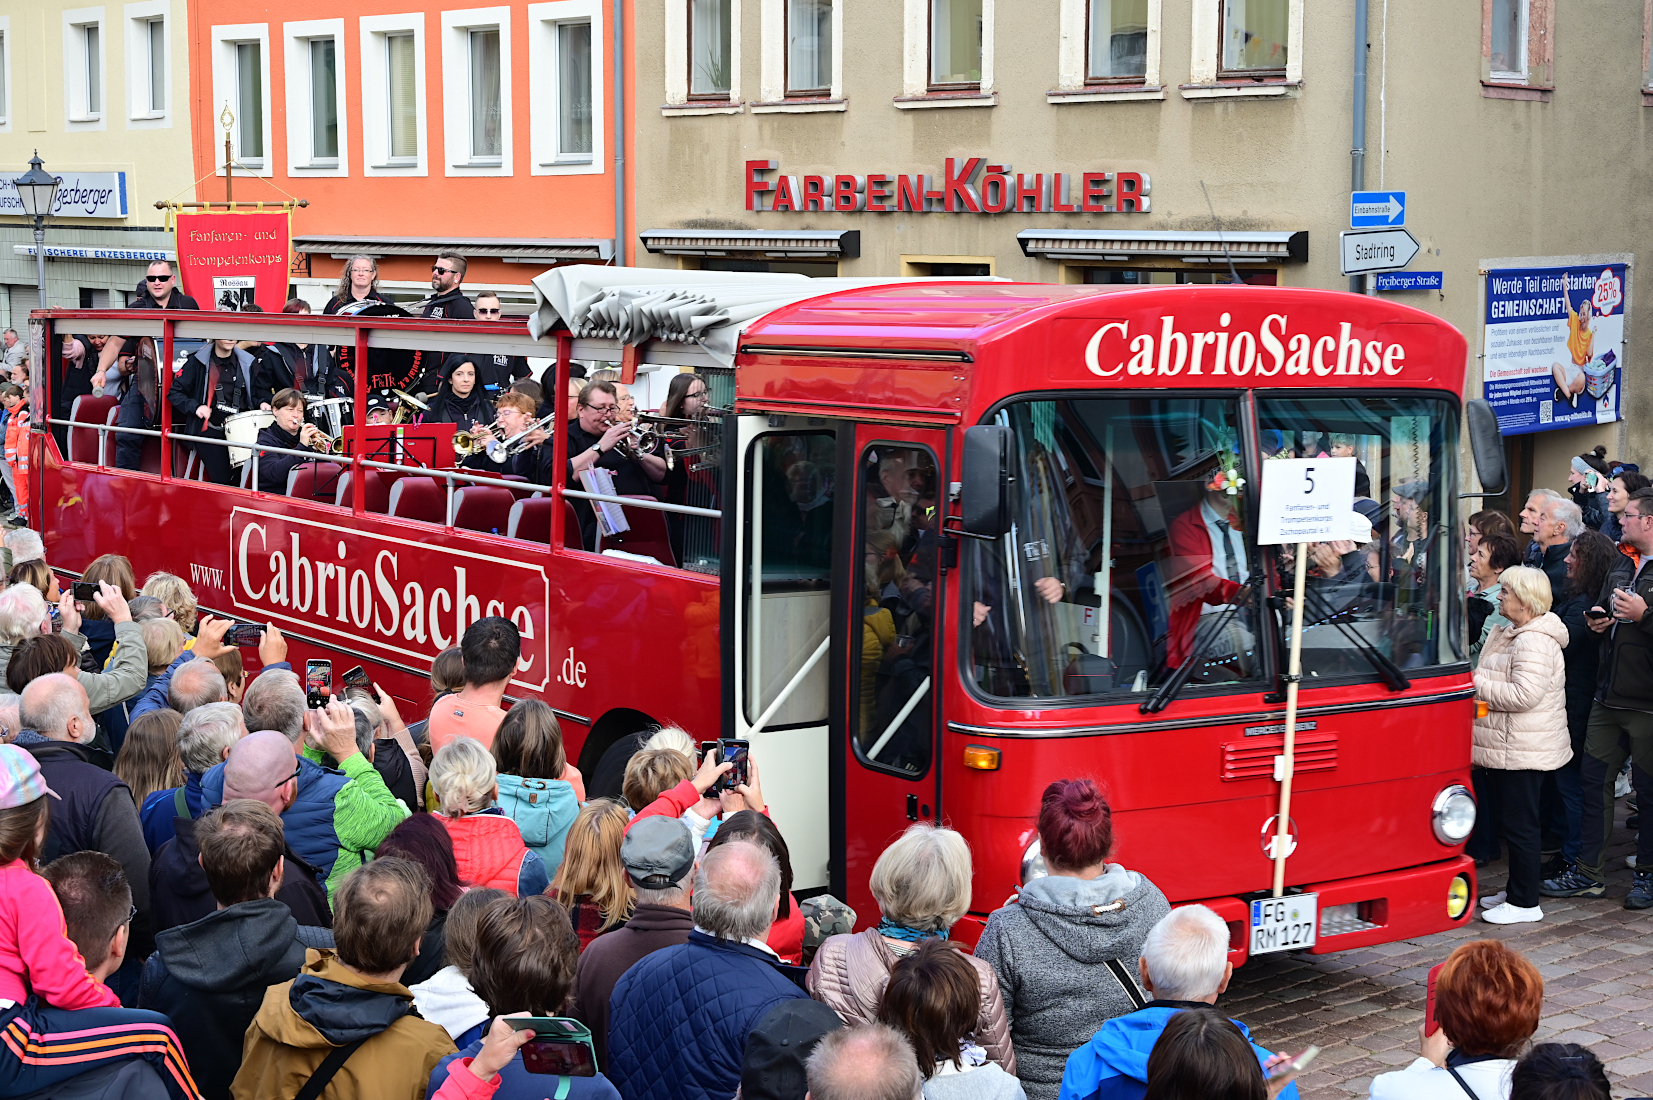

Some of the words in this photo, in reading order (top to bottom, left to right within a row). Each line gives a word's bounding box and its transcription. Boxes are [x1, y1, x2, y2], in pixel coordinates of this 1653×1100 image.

[745, 157, 1151, 214] FARBEN-KÖHLER
[1354, 205, 1390, 214] Einbahnstraße
[189, 230, 248, 244] Fanfaren-
[254, 228, 277, 240] und
[28, 248, 88, 258] FLISCHEREI
[94, 250, 166, 260] ENZESBERGER
[187, 253, 282, 268] Trompetenkorps
[1356, 242, 1395, 262] Stadtring
[1378, 276, 1415, 288] Freiberger
[1416, 275, 1440, 286] Straße
[1492, 278, 1522, 294] Werde
[1524, 276, 1540, 293] Teil
[1542, 276, 1563, 292] einer
[1566, 274, 1597, 290] starken
[1598, 280, 1617, 302] 25%
[1084, 312, 1406, 377] CabrioSachse
[1497, 368, 1523, 377] Gemeinschaft
[1304, 467, 1315, 494] 5
[190, 562, 226, 592] www.
[556, 647, 587, 689] .de
[1084, 608, 1093, 624] F
[1264, 902, 1285, 925] FG
[1255, 927, 1277, 950] RM
[1281, 922, 1312, 946] 127
